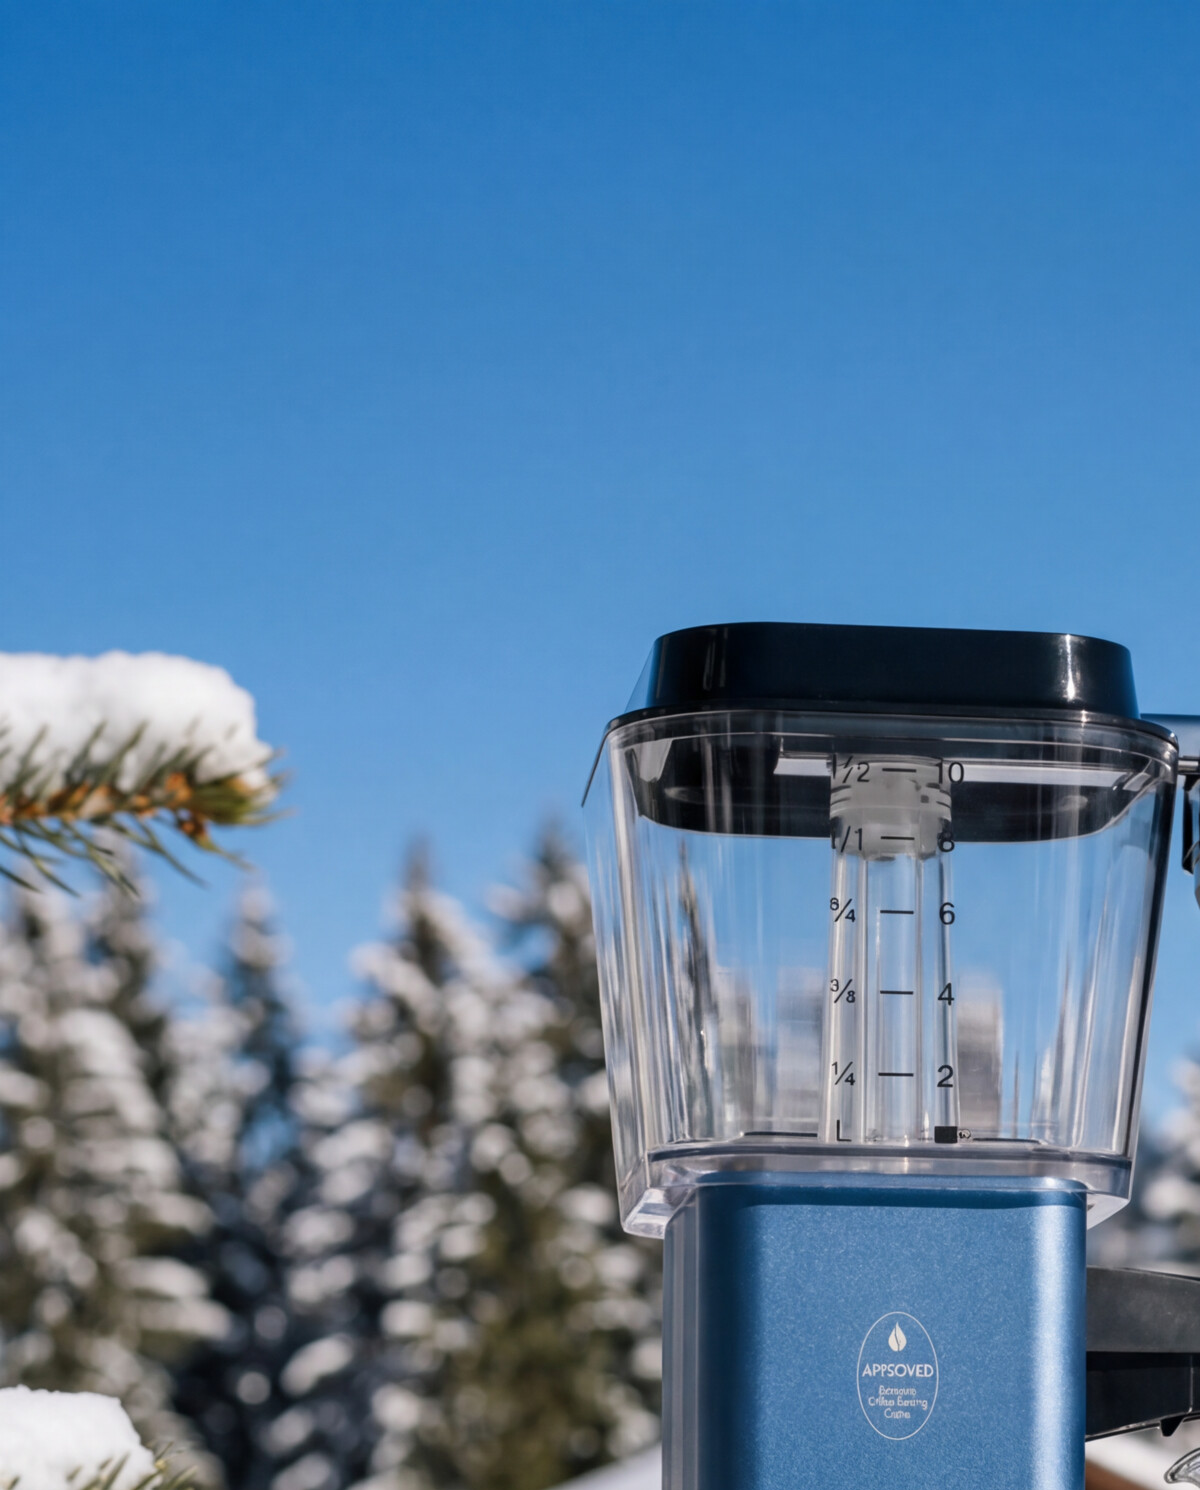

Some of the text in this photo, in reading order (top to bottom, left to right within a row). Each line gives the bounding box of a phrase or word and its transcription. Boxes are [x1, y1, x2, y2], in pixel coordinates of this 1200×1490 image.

[935, 761, 965, 784] 10
[939, 902, 956, 925] 6
[937, 982, 955, 1006] 4
[831, 1061, 954, 1088] 1/4 2
[836, 1119, 852, 1142] L
